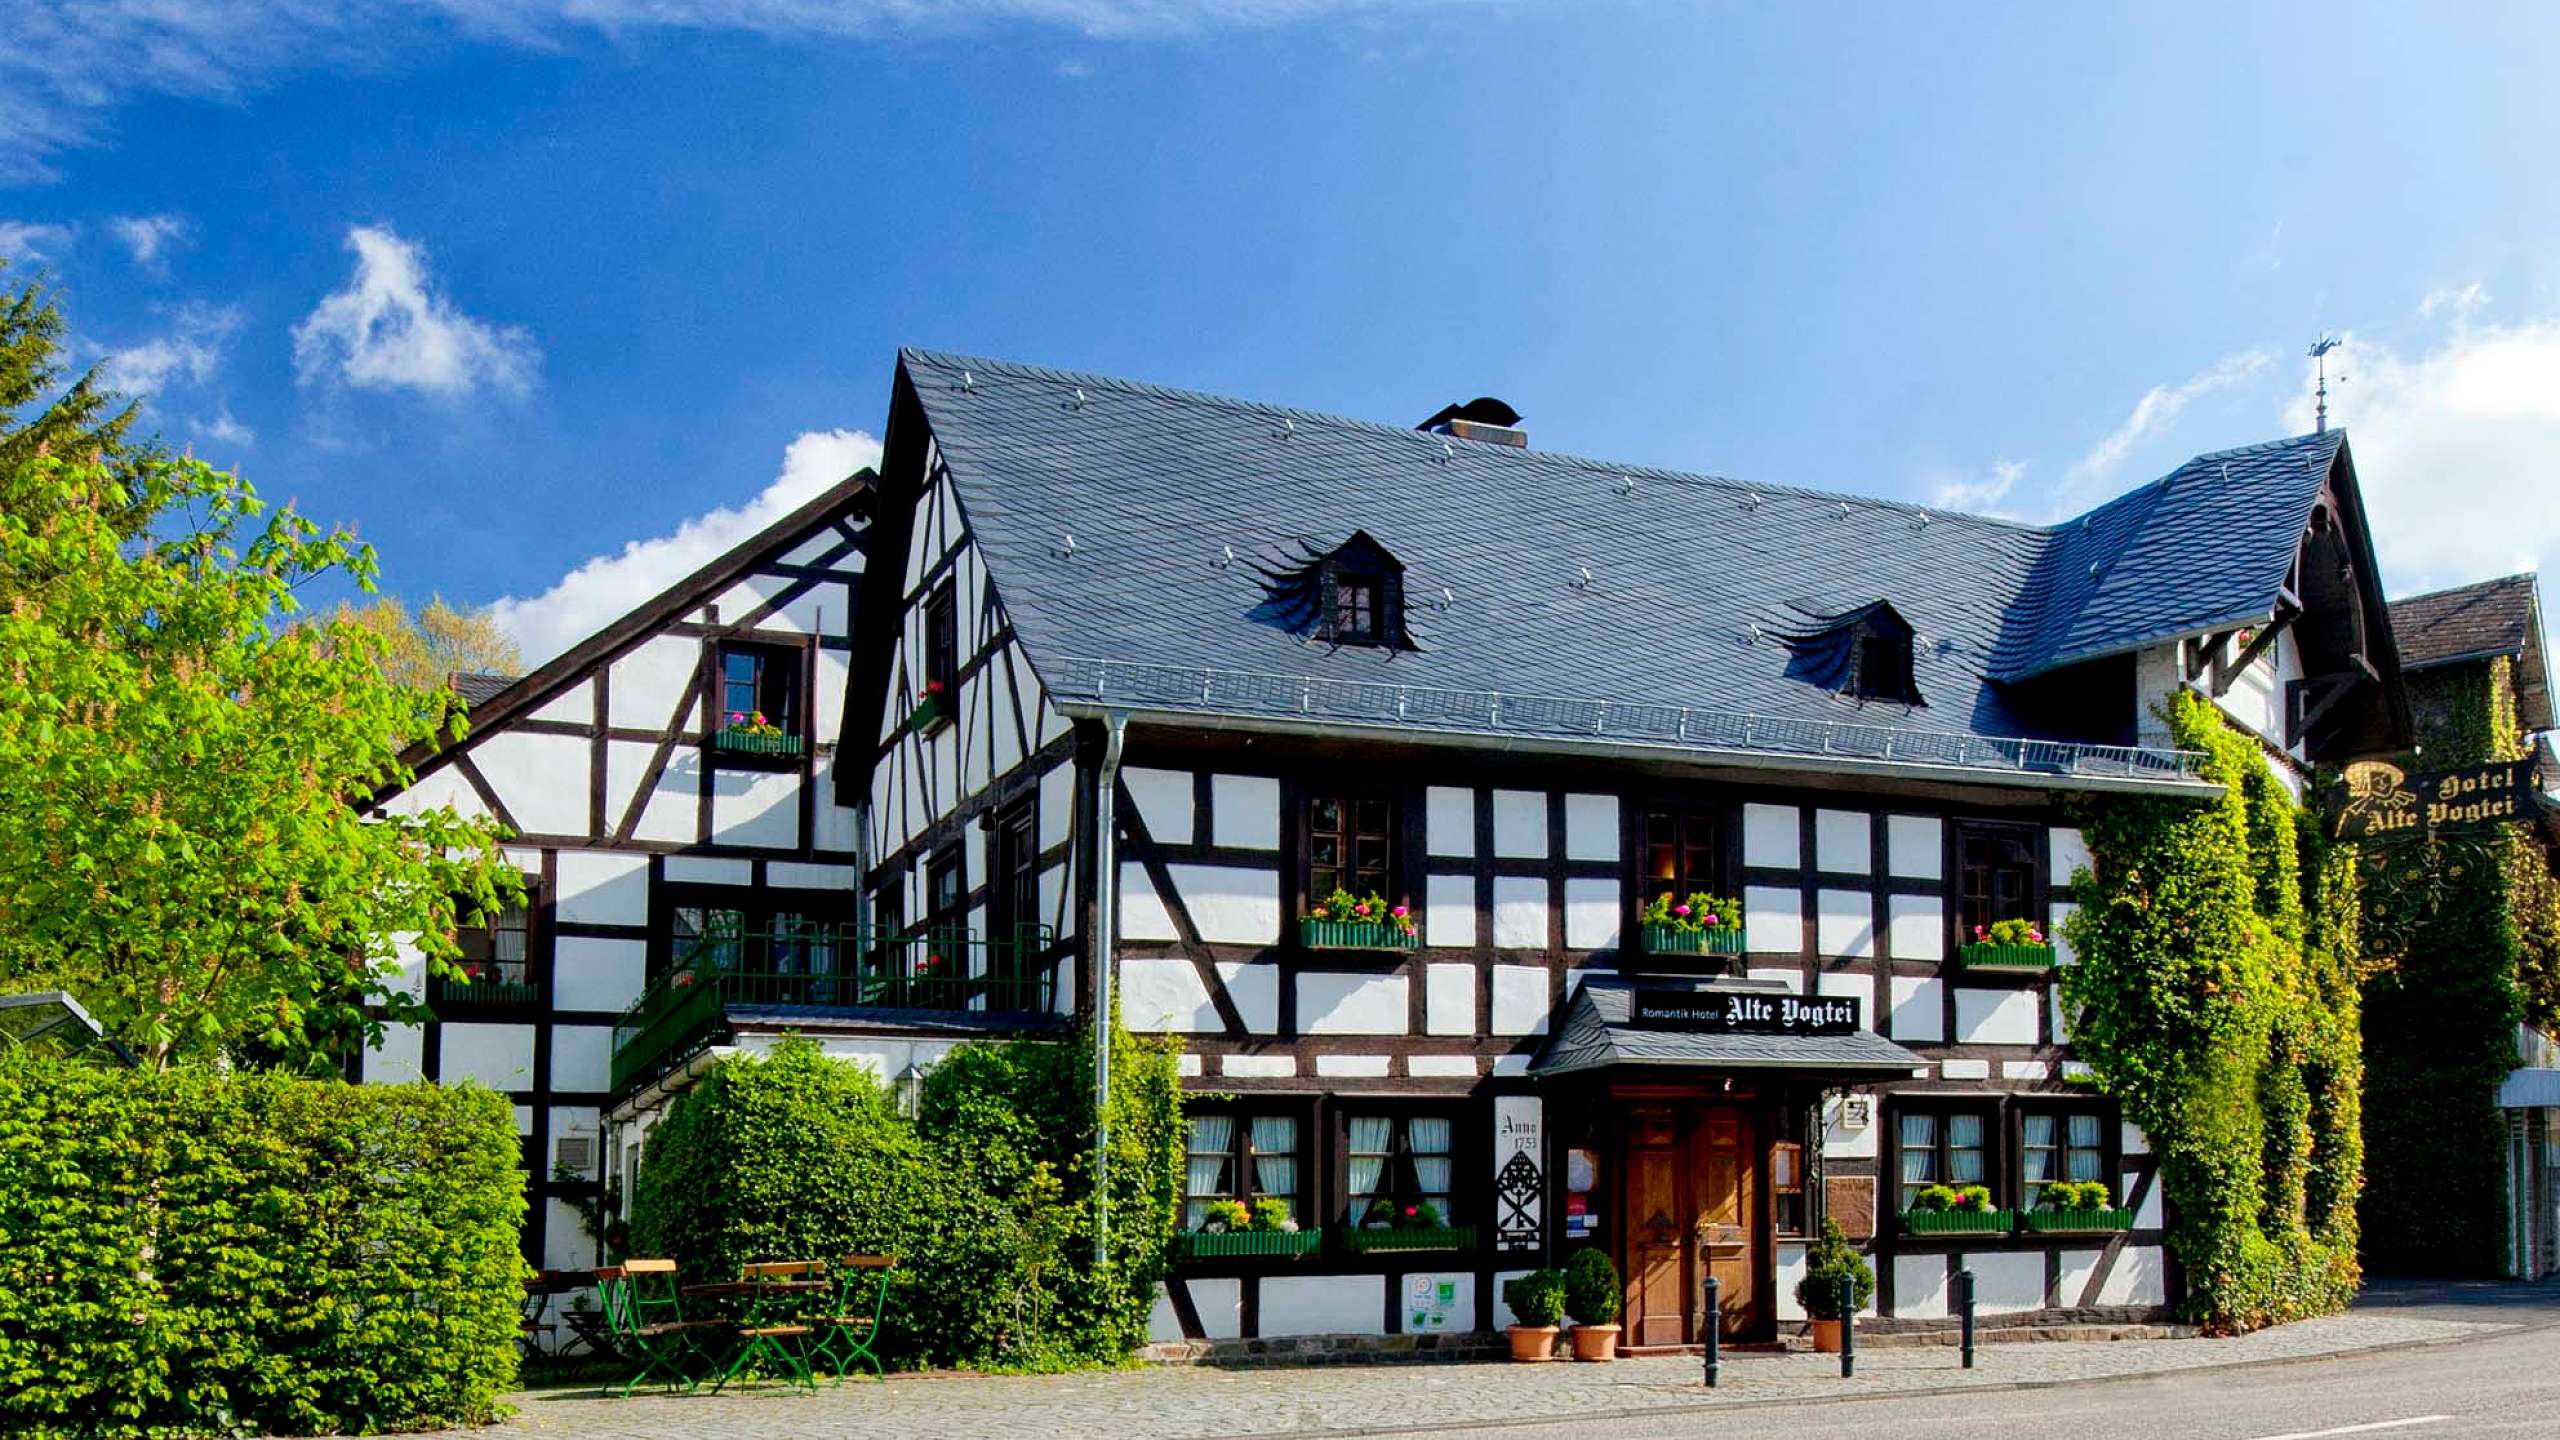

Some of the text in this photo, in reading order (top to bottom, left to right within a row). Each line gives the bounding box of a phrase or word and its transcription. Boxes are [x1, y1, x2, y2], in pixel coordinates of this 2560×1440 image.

[2438, 768, 2515, 800] Hotel
[2364, 796, 2516, 836] Alte Vogtei
[1642, 1007, 1719, 1020] Romantik Hotel
[1726, 996, 1852, 1027] Alte Vogtei
[1501, 1114, 1536, 1137] Anno
